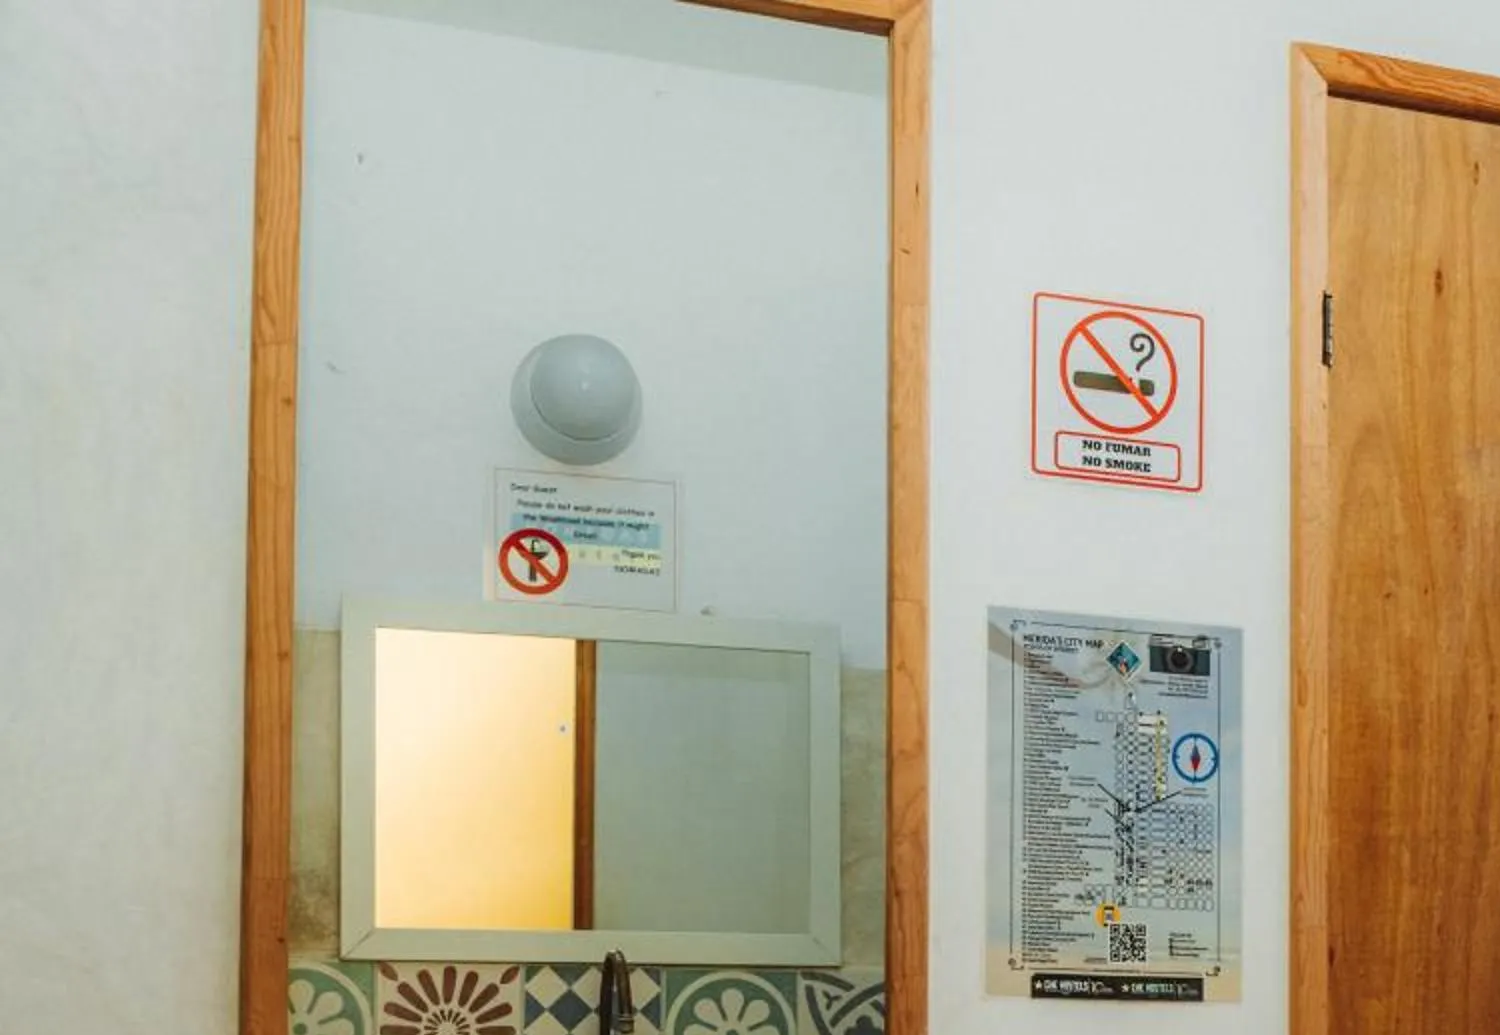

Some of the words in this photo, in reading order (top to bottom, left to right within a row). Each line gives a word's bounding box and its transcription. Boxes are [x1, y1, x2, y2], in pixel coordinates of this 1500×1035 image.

[1082, 439, 1102, 451] NO
[1105, 441, 1151, 457] FUMAR
[1082, 455, 1102, 467] NO
[1105, 457, 1152, 472] SMOKE
